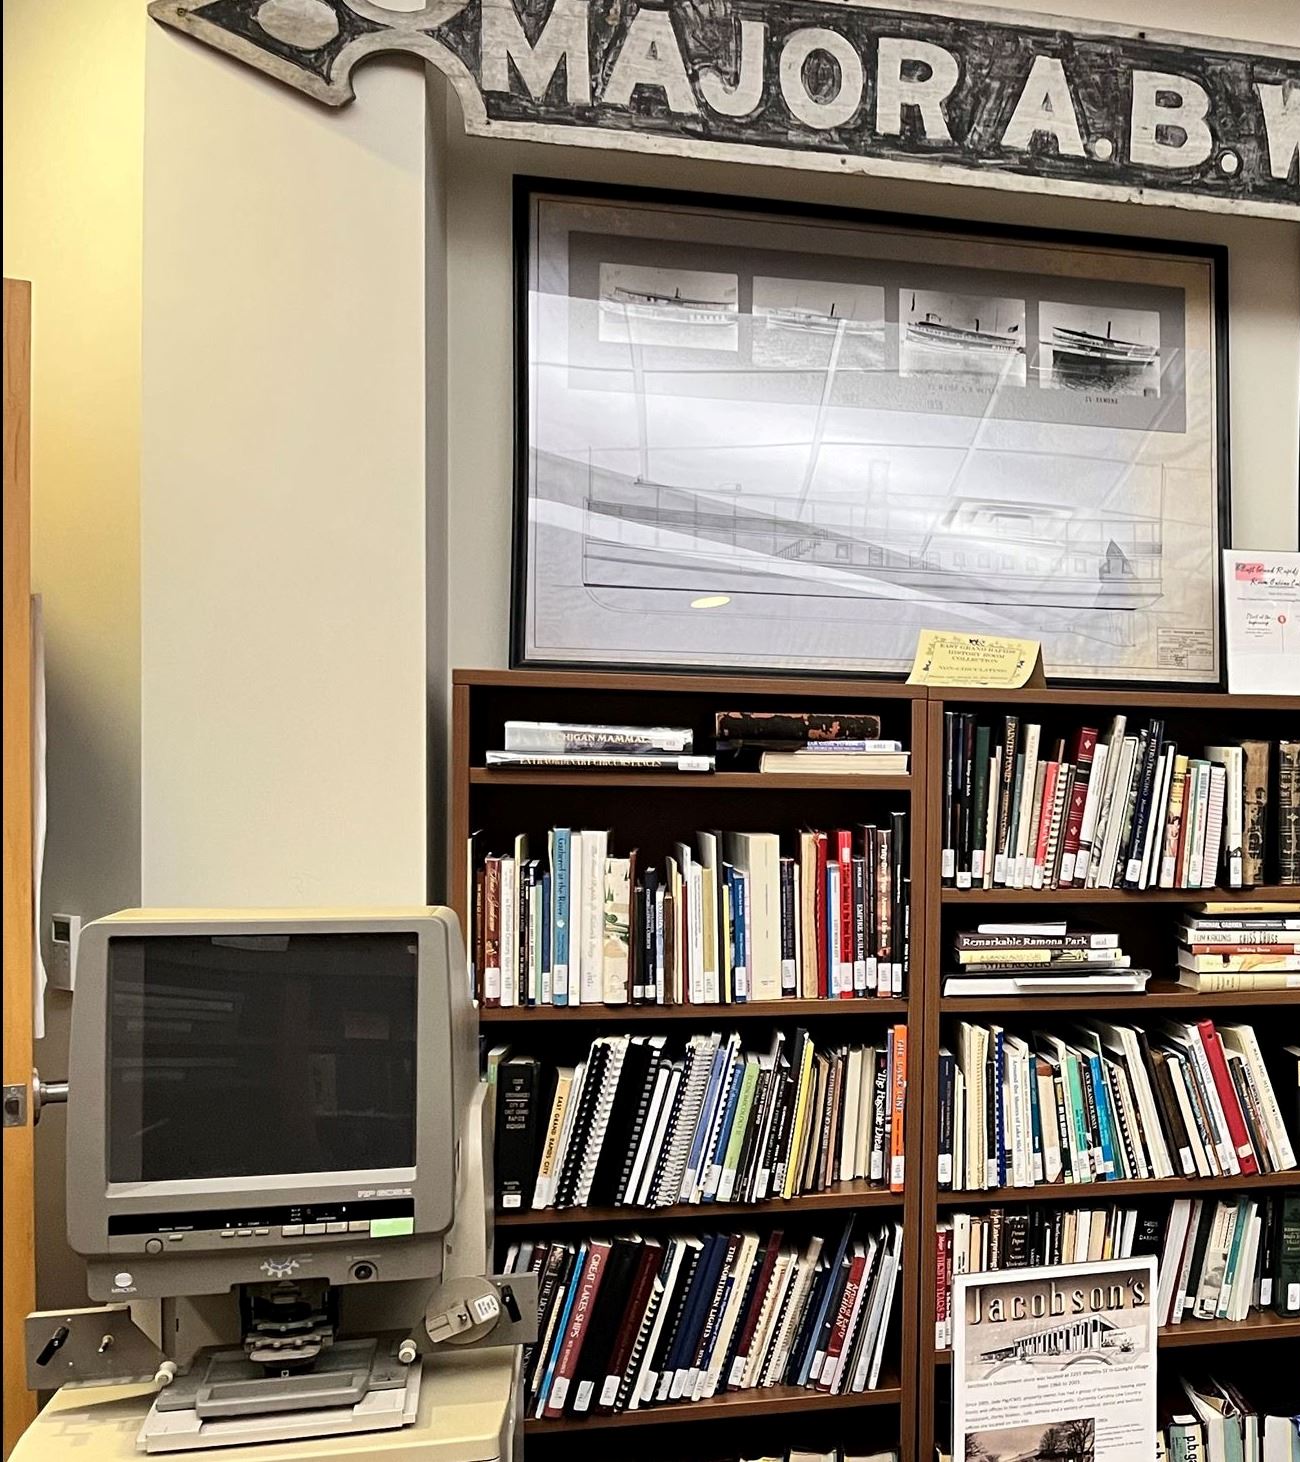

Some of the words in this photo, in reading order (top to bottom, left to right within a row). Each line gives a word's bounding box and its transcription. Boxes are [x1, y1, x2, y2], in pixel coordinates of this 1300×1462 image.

[479, 0, 968, 148] MAJOR
[962, 937, 1022, 947] Remarkable
[1023, 937, 1063, 946] Ramona
[1065, 937, 1088, 946] Park
[835, 1282, 853, 1328] MICHIGAN
[969, 1276, 1147, 1326] Jacobson's
